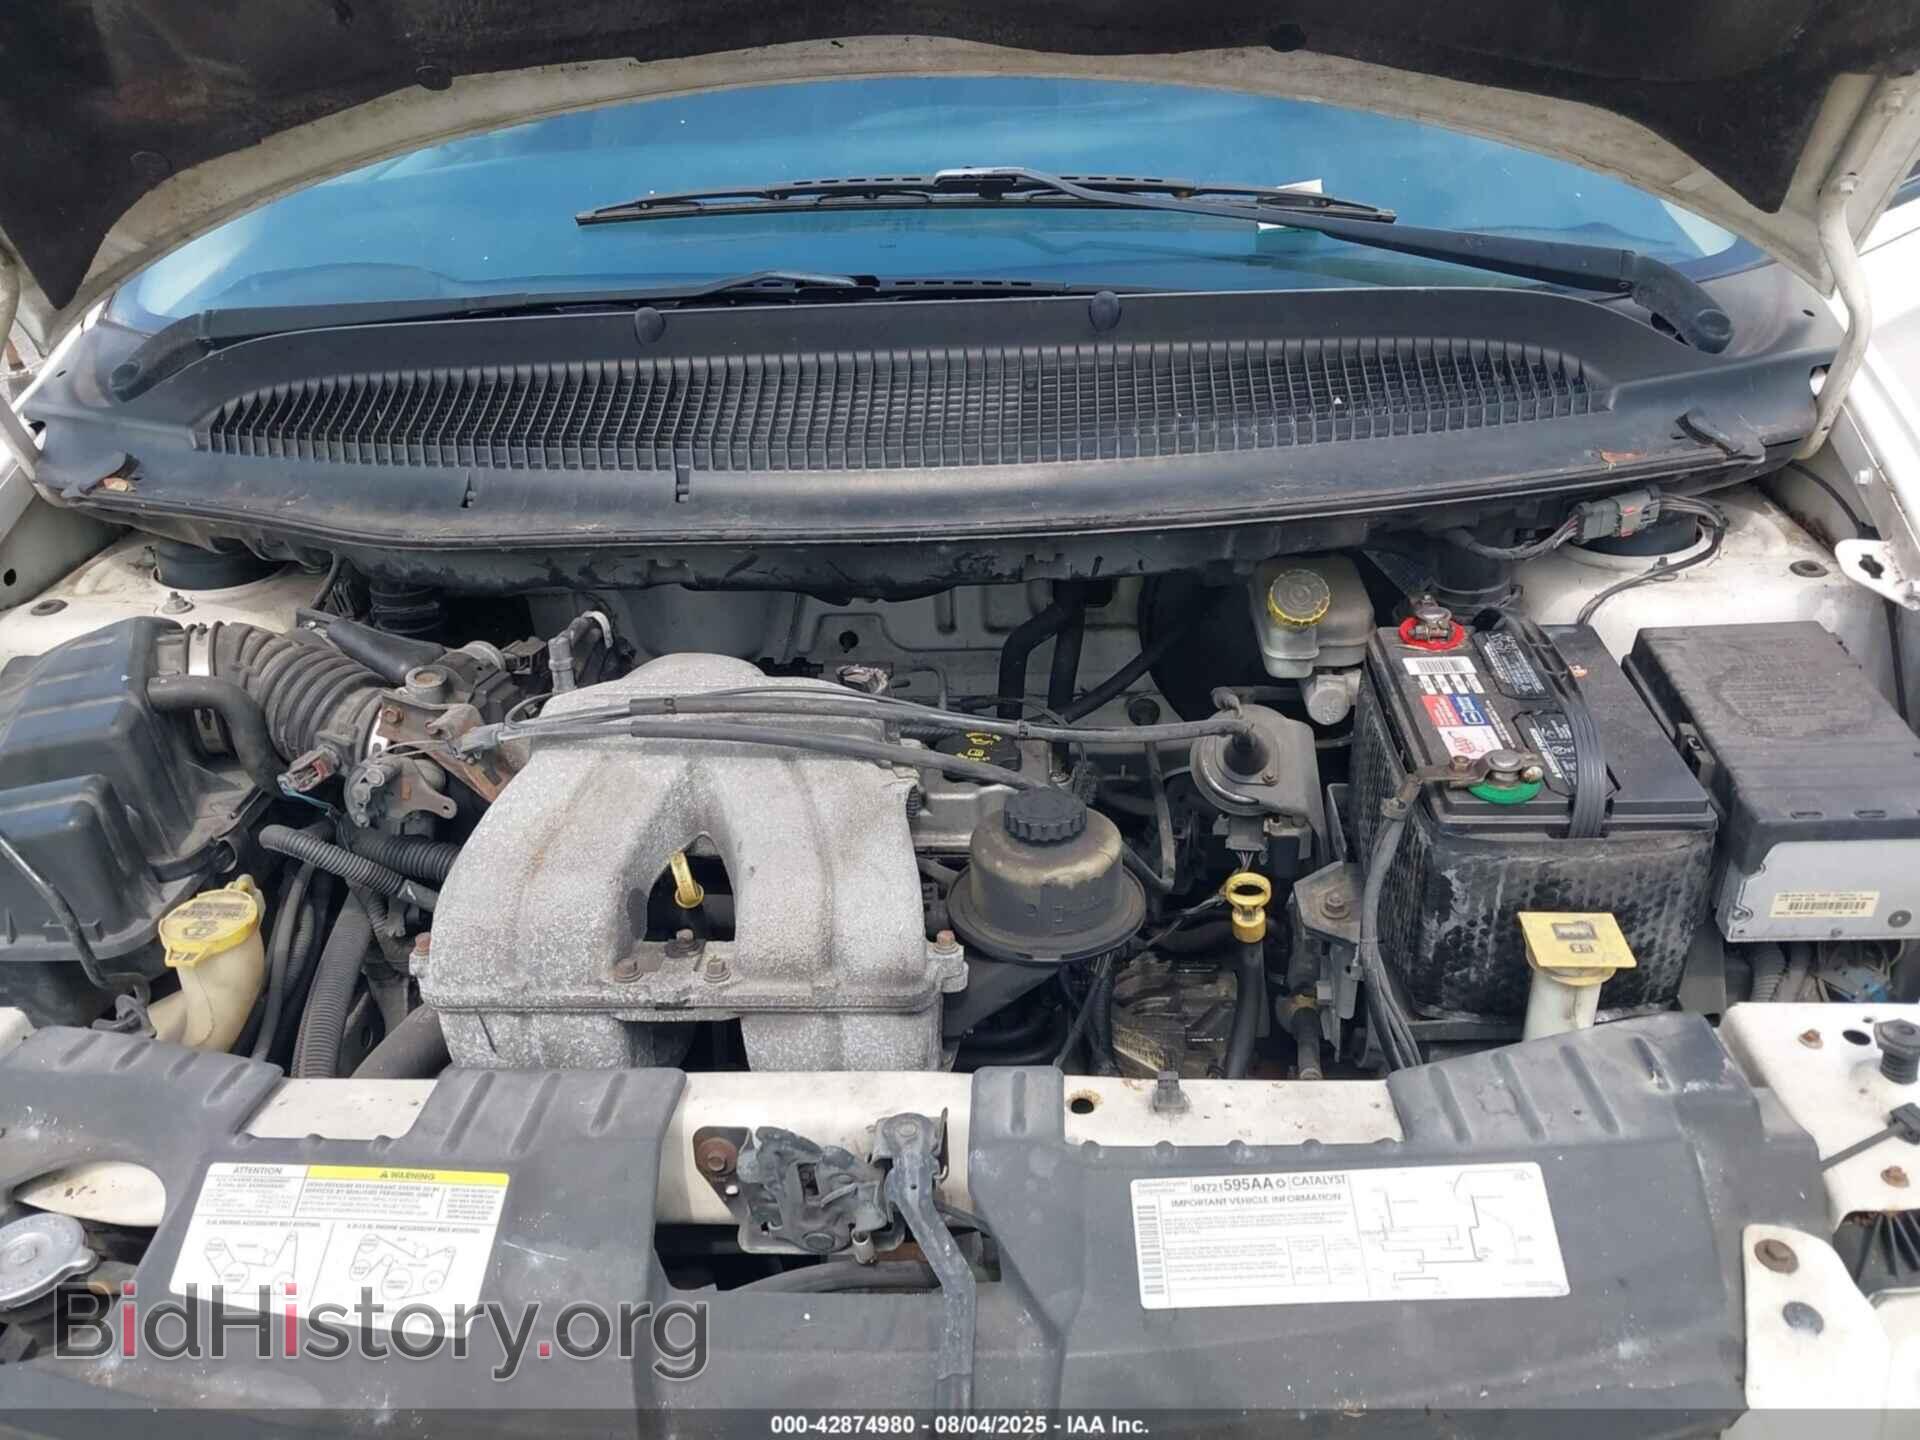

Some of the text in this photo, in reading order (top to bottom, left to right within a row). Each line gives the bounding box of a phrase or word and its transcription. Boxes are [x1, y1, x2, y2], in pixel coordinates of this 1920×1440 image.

[232, 1166, 283, 1176] ATTENTION
[390, 1170, 436, 1181] WARNING
[1291, 1174, 1346, 1187] CATALYST
[1171, 1191, 1342, 1208] IMPORTANT VEHICLE INFORMATION
